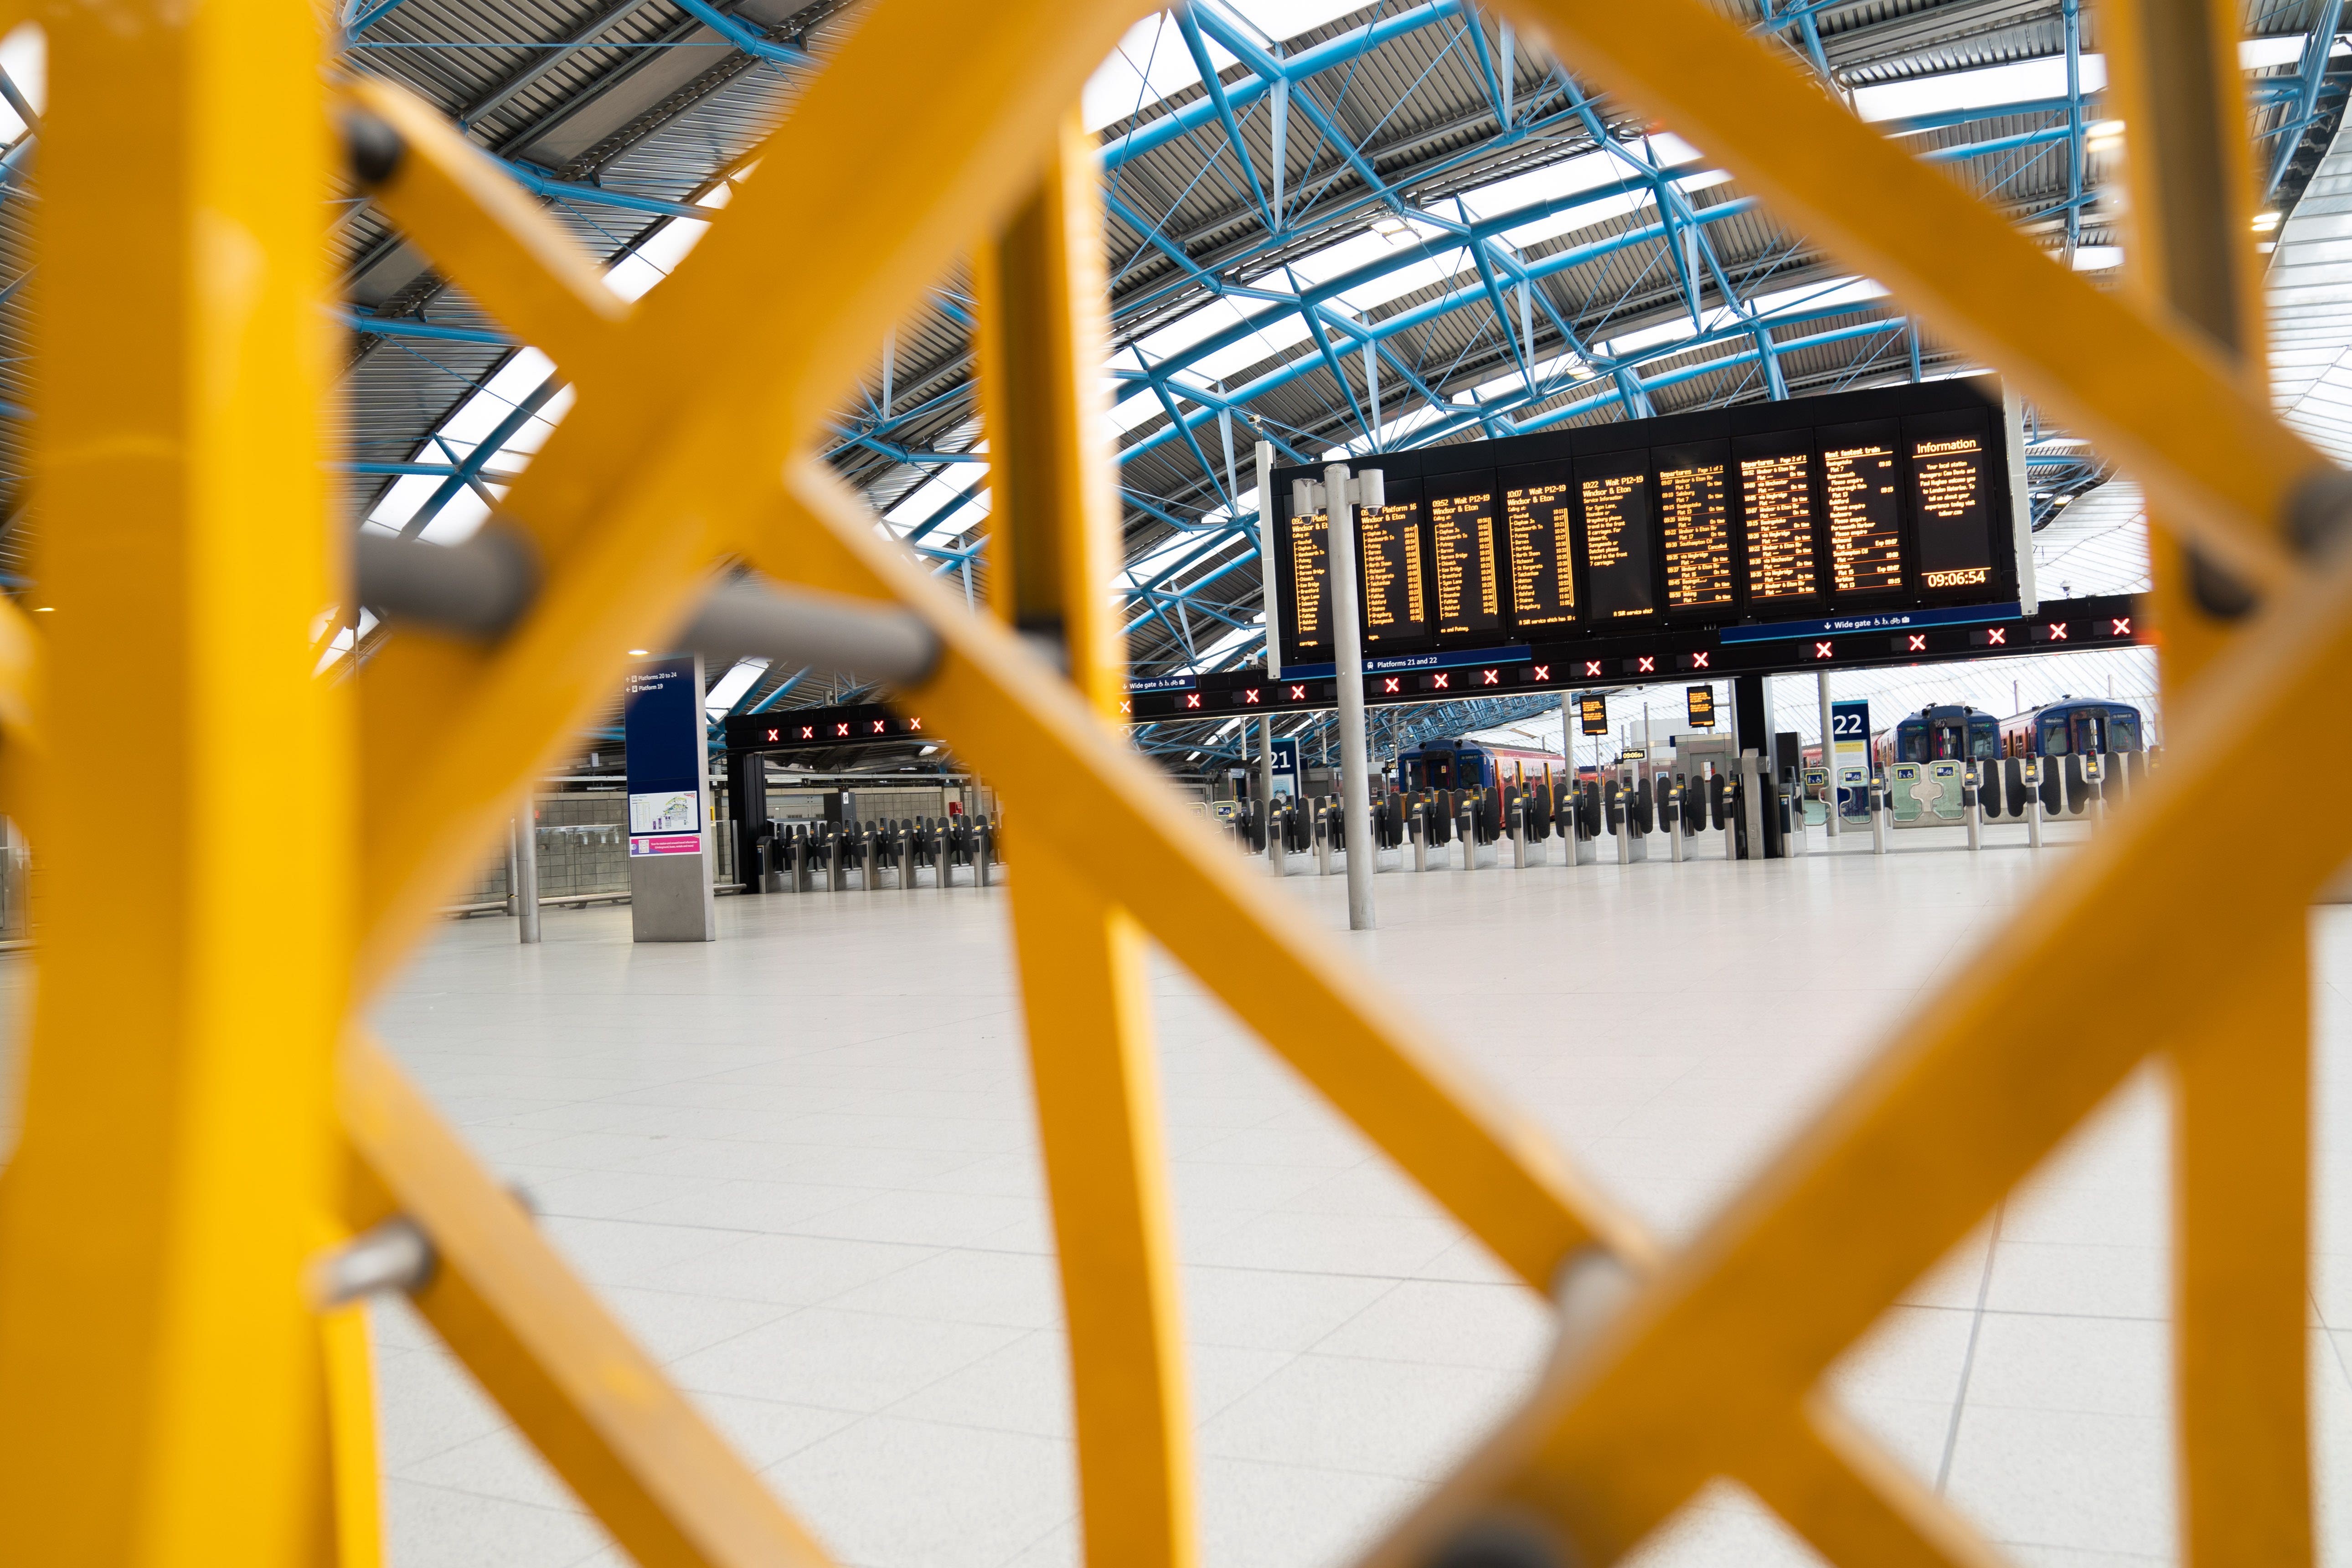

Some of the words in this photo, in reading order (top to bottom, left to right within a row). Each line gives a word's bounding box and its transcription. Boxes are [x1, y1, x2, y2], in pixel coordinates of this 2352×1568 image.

[1917, 439, 1976, 454] Information
[1825, 451, 1839, 459] Next
[1840, 448, 1864, 457] fastest
[1864, 446, 1880, 454] train
[1741, 459, 1774, 469] Departures
[1660, 469, 1692, 478] Departures
[1605, 479, 1620, 487] Wait
[1621, 475, 1644, 485] P12-19
[1529, 487, 1543, 495] Wait
[1544, 485, 1566, 494] P12-19
[1583, 489, 1608, 498] Windsor
[1454, 497, 1468, 505] Wait
[1469, 494, 1490, 503] P12-19
[1507, 498, 1531, 506] Windsor
[1381, 505, 1408, 514] Platform
[1433, 507, 1456, 516] Windsor
[1361, 516, 1384, 524] Windsor
[1292, 523, 1314, 532] Windsor
[1928, 571, 1986, 587] 09:06:54
[1854, 620, 1871, 629] gate
[1833, 714, 1862, 734] 22
[1271, 751, 1290, 769] 21
